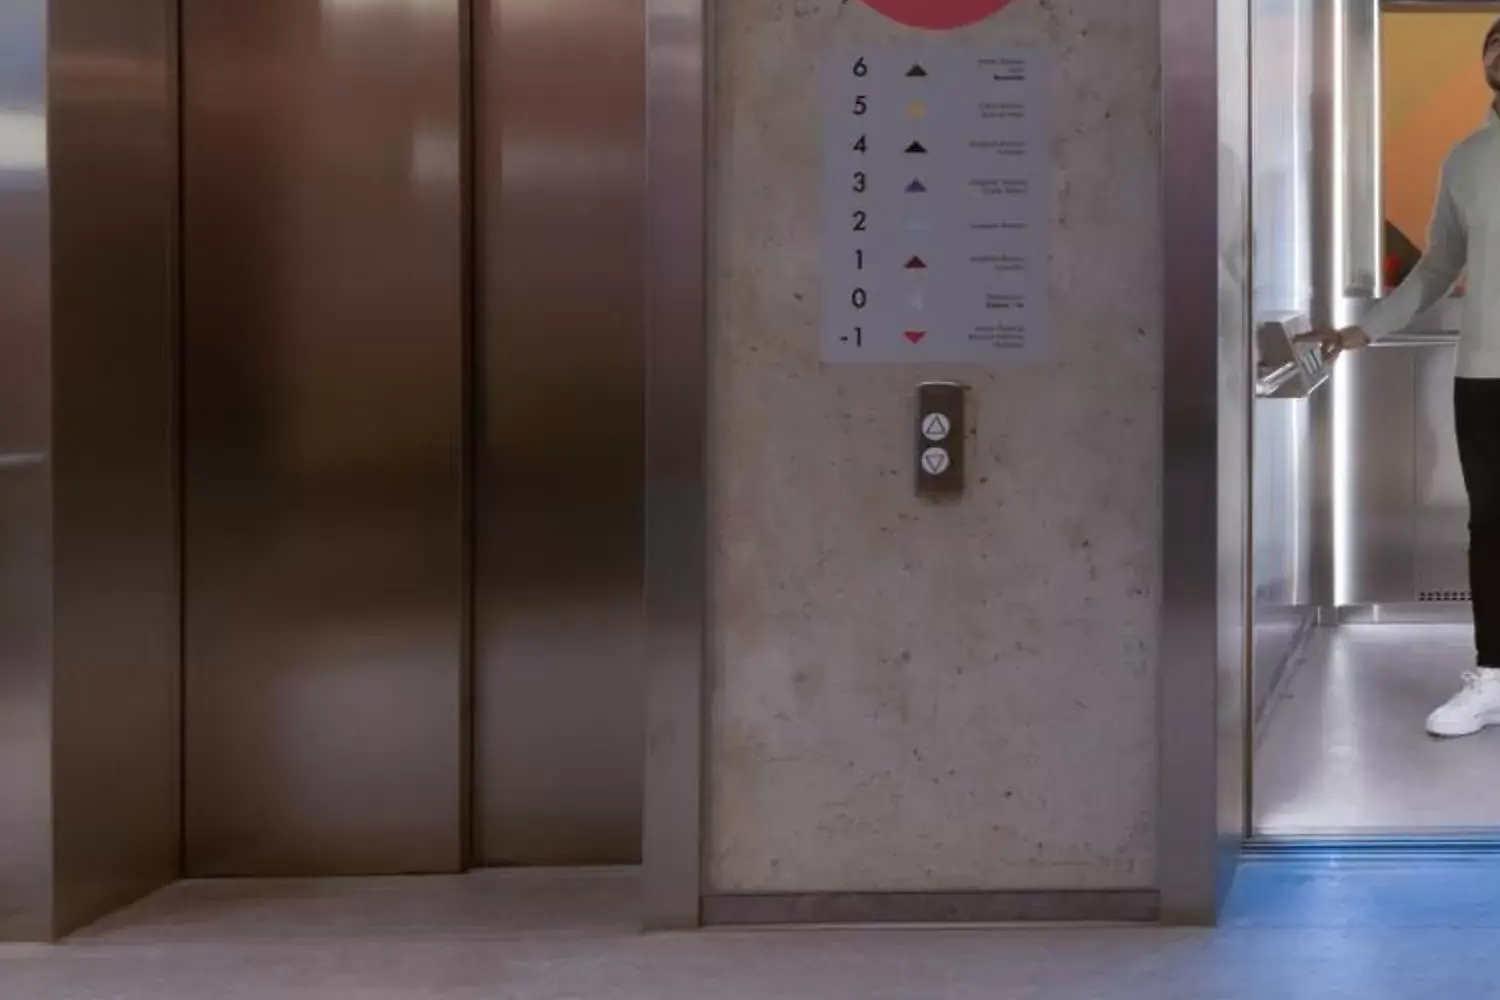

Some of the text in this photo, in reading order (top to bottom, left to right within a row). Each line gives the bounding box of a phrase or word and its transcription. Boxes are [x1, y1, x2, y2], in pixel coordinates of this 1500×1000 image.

[852, 57, 868, 78] 6
[852, 95, 867, 115] 5
[852, 135, 867, 153] 4
[852, 171, 866, 193] 3
[852, 210, 867, 231] 2
[855, 249, 863, 270] 1
[851, 287, 867, 309] 0
